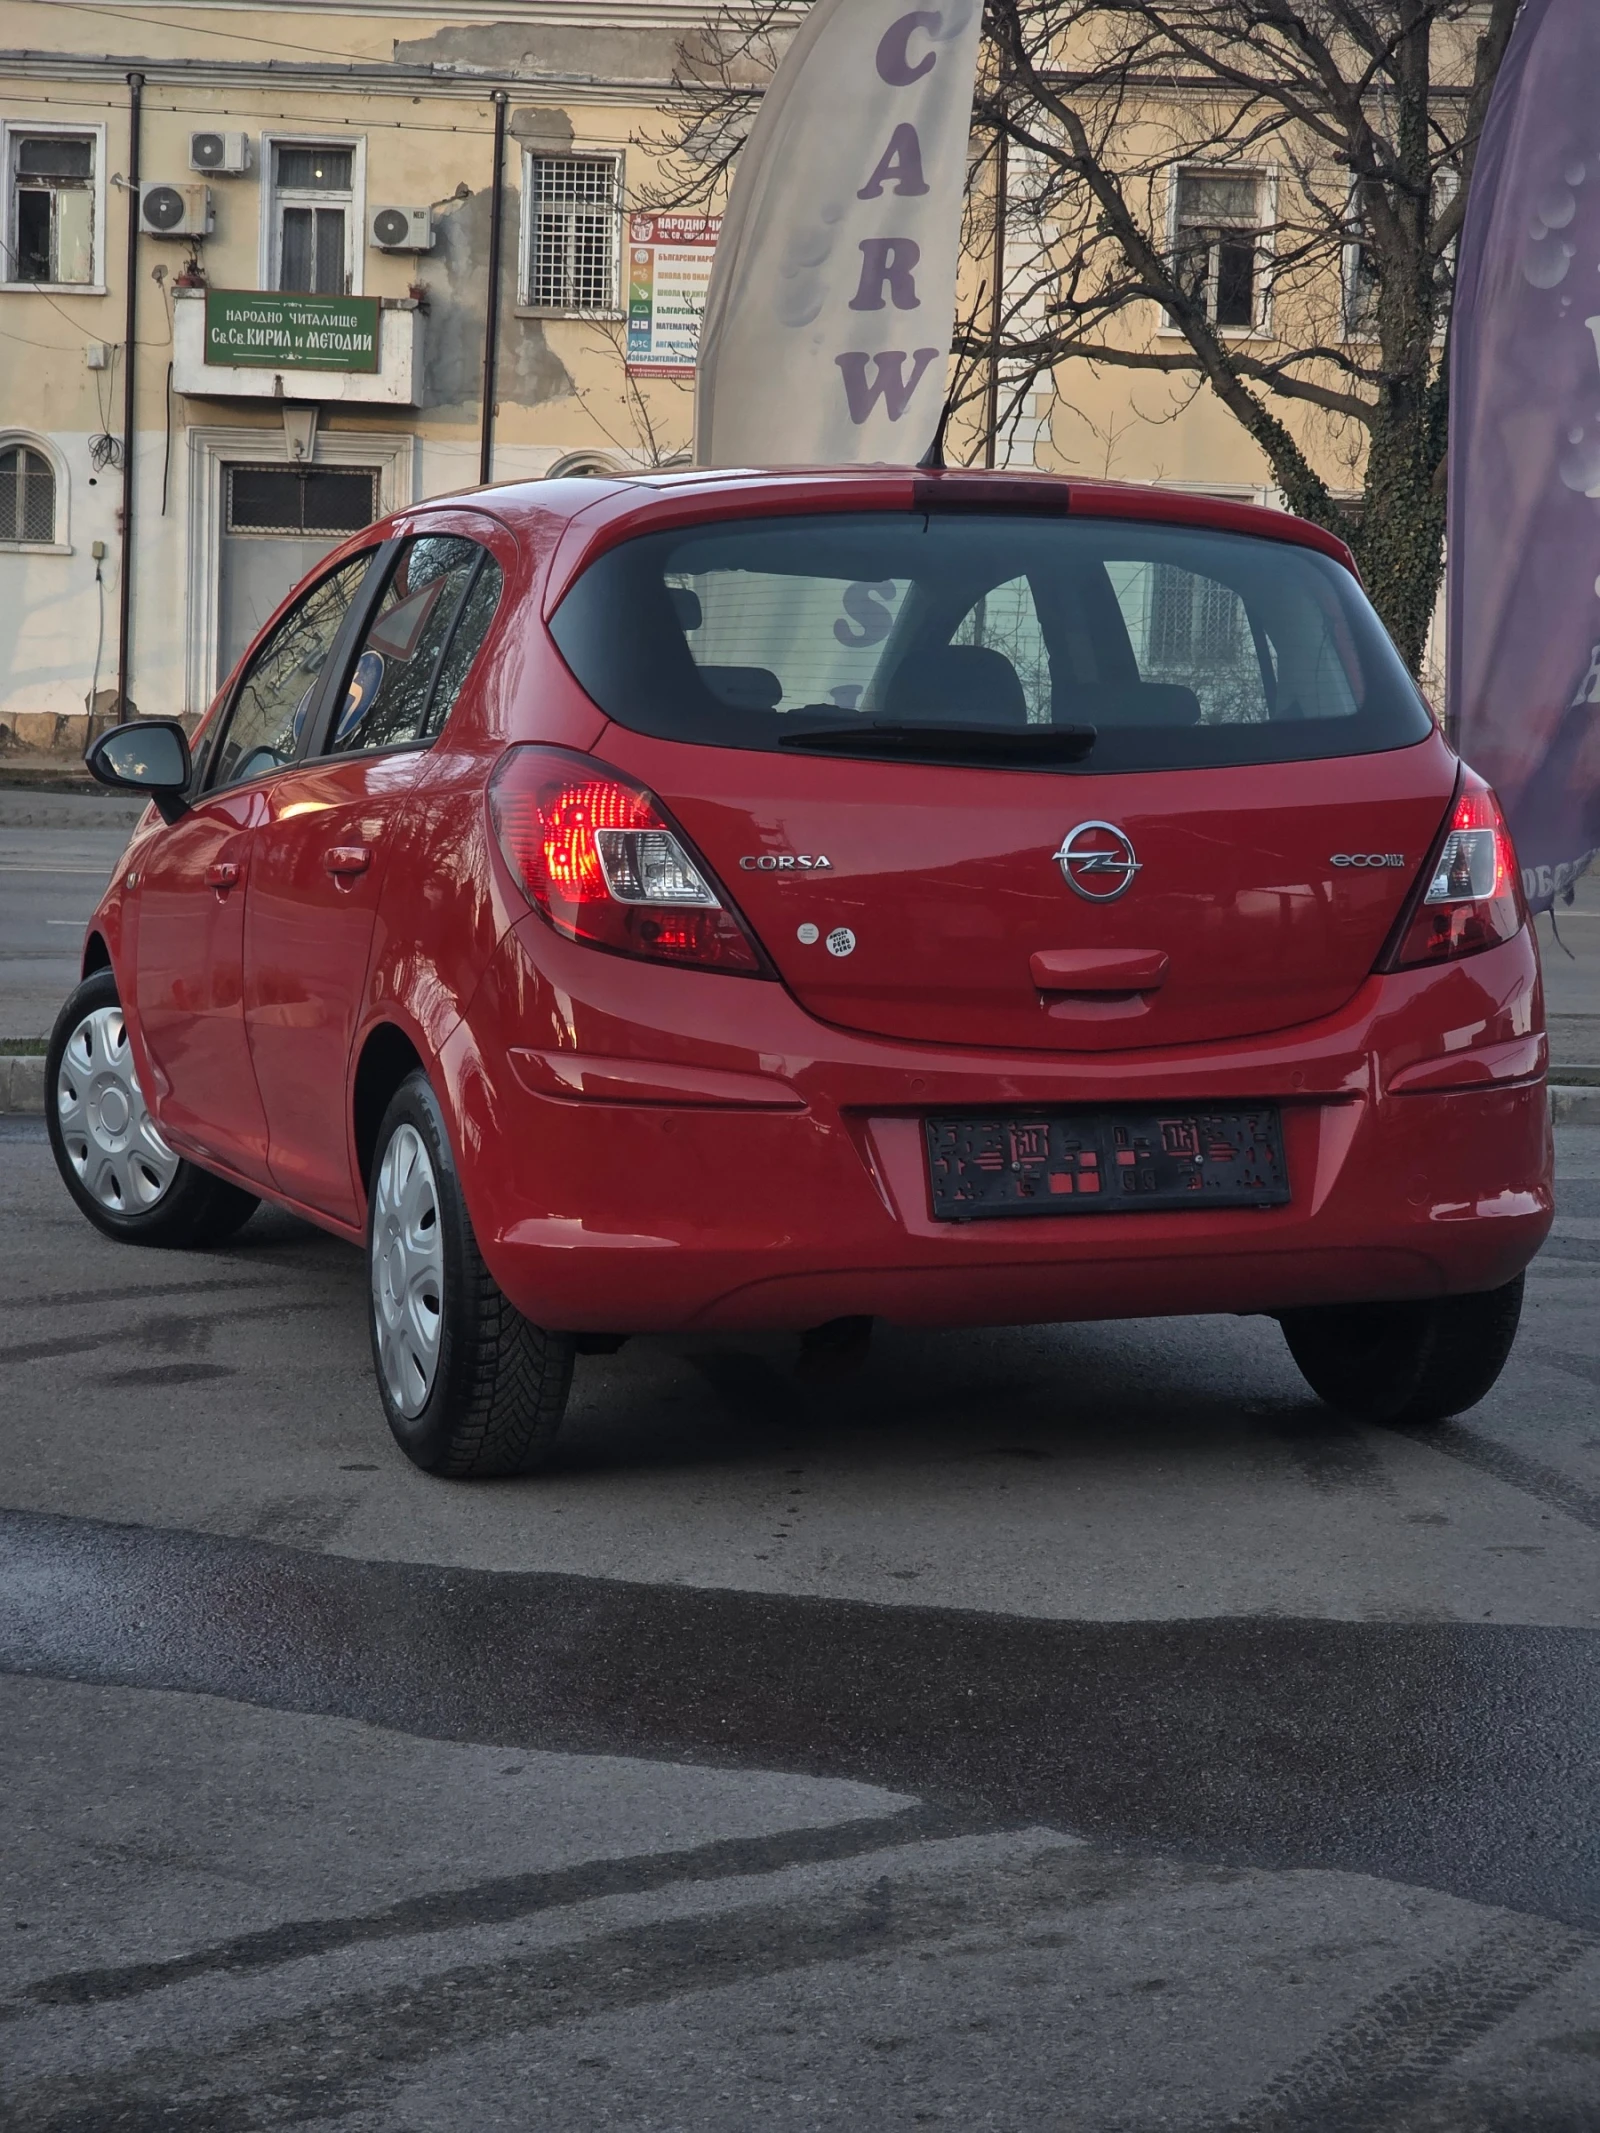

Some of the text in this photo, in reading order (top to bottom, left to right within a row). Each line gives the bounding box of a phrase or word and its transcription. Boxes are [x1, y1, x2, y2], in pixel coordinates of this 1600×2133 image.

[657, 217, 722, 231] НАРОДНО ЧИ
[658, 253, 696, 262] БЪЛГАРСКИ
[226, 309, 358, 328] НАРОДНО ЧИТАЛИЩЕ
[246, 328, 292, 348] КИРИЛ
[306, 331, 373, 352] МЕТОДИЙ
[738, 855, 834, 872] CORSA
